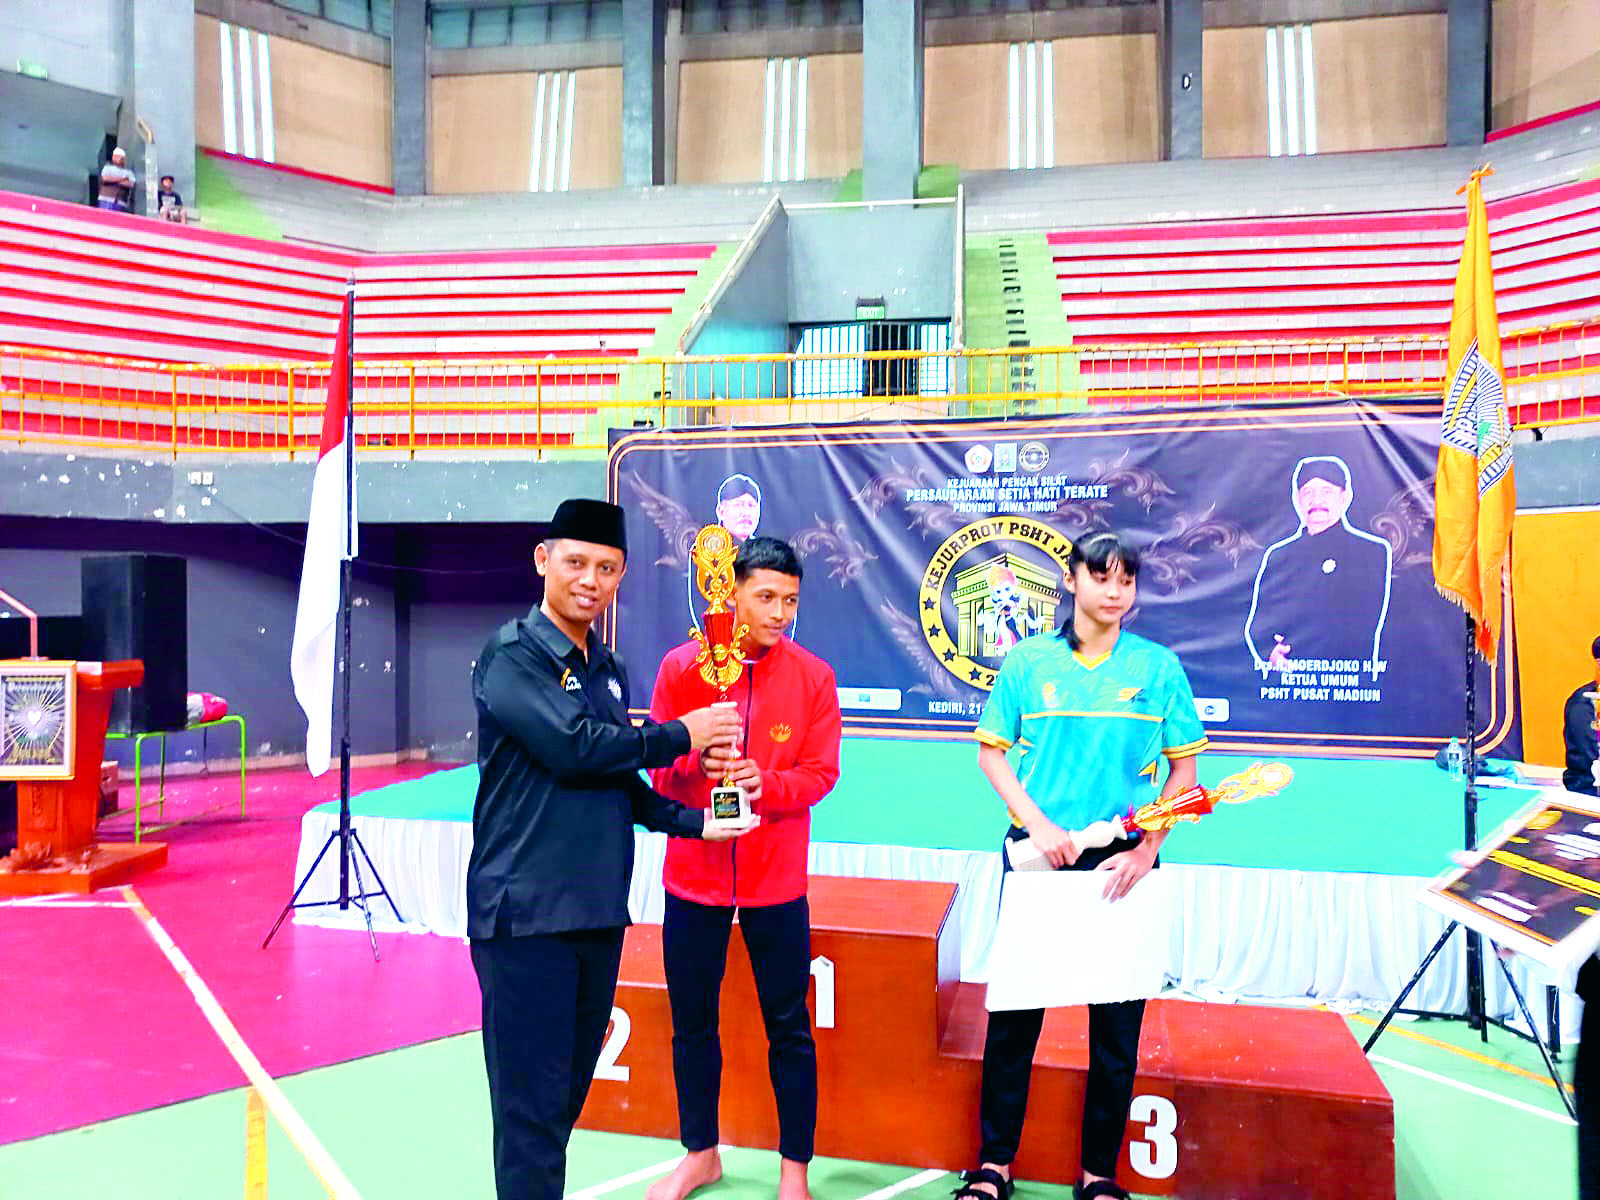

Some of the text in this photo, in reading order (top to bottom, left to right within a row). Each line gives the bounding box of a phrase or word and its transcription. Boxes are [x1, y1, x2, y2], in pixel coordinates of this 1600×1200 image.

[947, 475, 1068, 489] KEJUARAAN PENCAK SILAT
[906, 485, 1108, 501] PERSAUDARAAN SETIA HATI TERATE
[953, 500, 1057, 513] PROVINSI JAWA TIMUR
[925, 522, 1004, 590] KEJURPROV
[1009, 522, 1055, 545] PSHT
[1281, 672, 1359, 687] KETUA UMUM
[1260, 687, 1381, 702] PSHT PUSAT MADIUN
[928, 701, 966, 716] KEDIRI,
[809, 954, 835, 1029] 1
[592, 1005, 631, 1082] 2
[1129, 1094, 1178, 1179] 3
